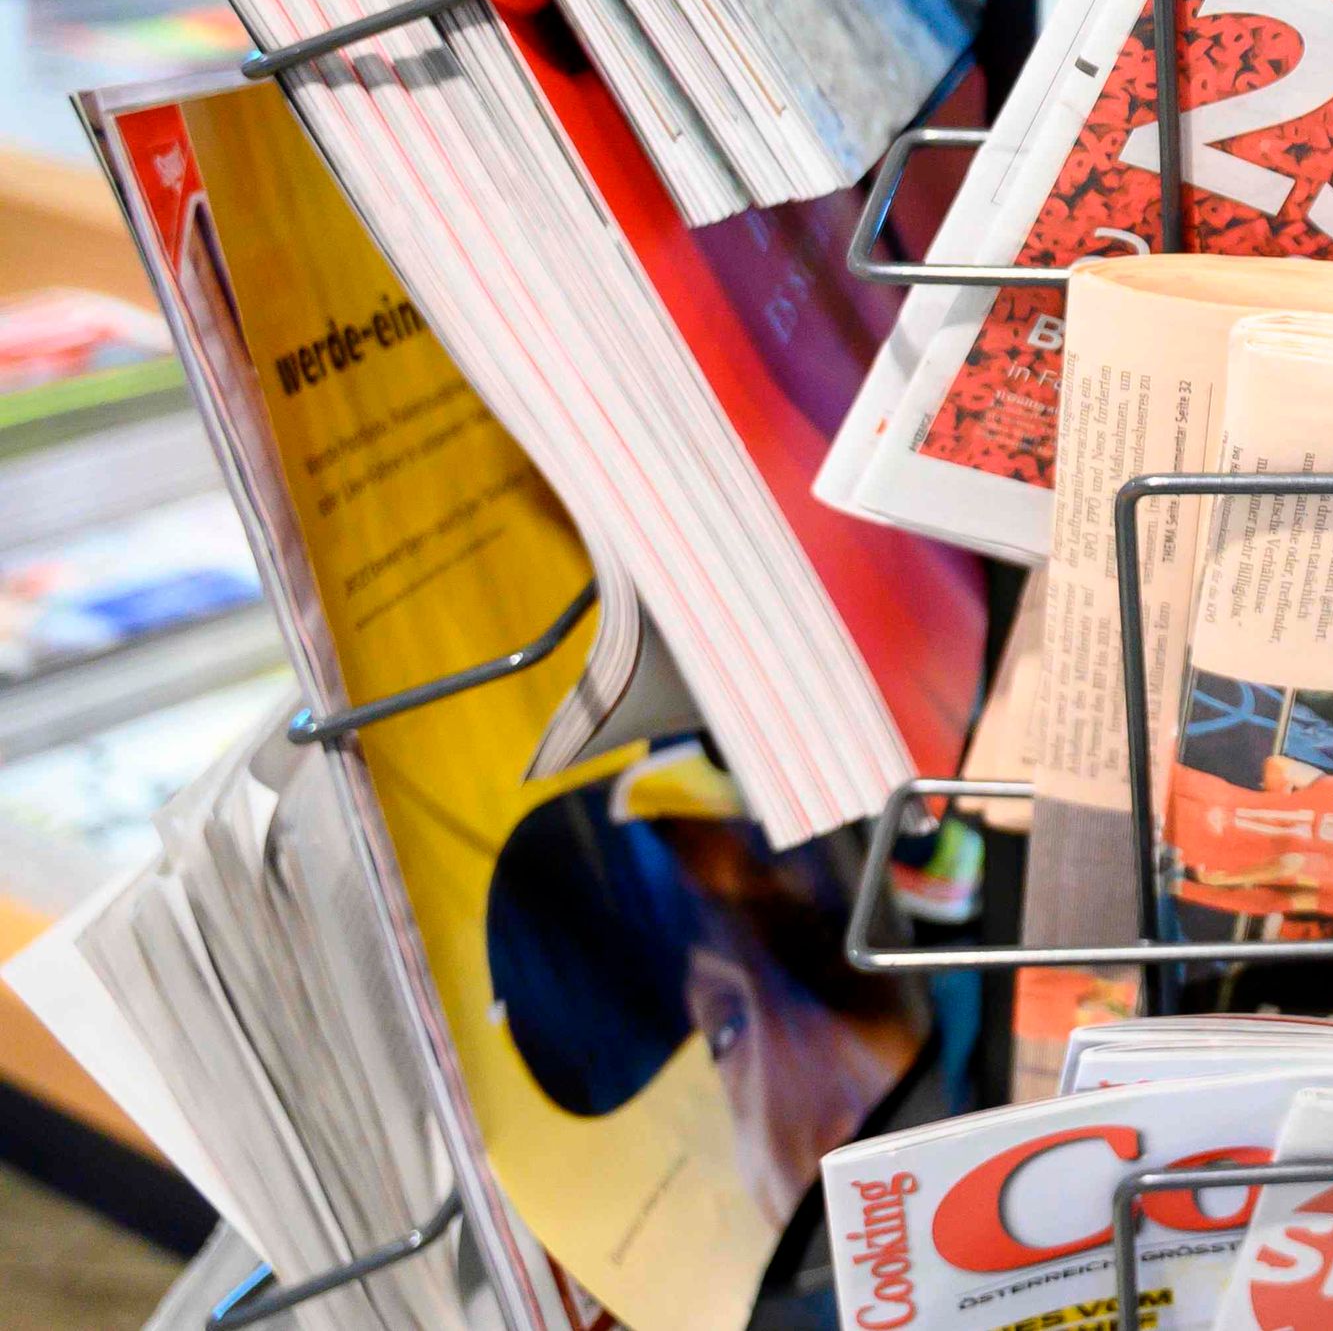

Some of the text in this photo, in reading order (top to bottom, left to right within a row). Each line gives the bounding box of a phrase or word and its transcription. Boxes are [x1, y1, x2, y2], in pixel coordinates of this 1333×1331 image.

[1118, 370, 1131, 391] um
[1140, 374, 1151, 390] zu
[1178, 379, 1192, 394] 32
[1174, 395, 1190, 423] Seite
[1091, 430, 1107, 460] Neos
[1240, 525, 1256, 559] mehr
[1309, 504, 1330, 550] drohen
[1161, 528, 1176, 562] THEMA
[1253, 537, 1279, 613] Verhältnisse
[1296, 552, 1320, 619] tatsächlich
[1268, 545, 1298, 644] oder, treffender,
[1314, 594, 1333, 642] geführt.
[846, 1171, 917, 1331] Cooking
